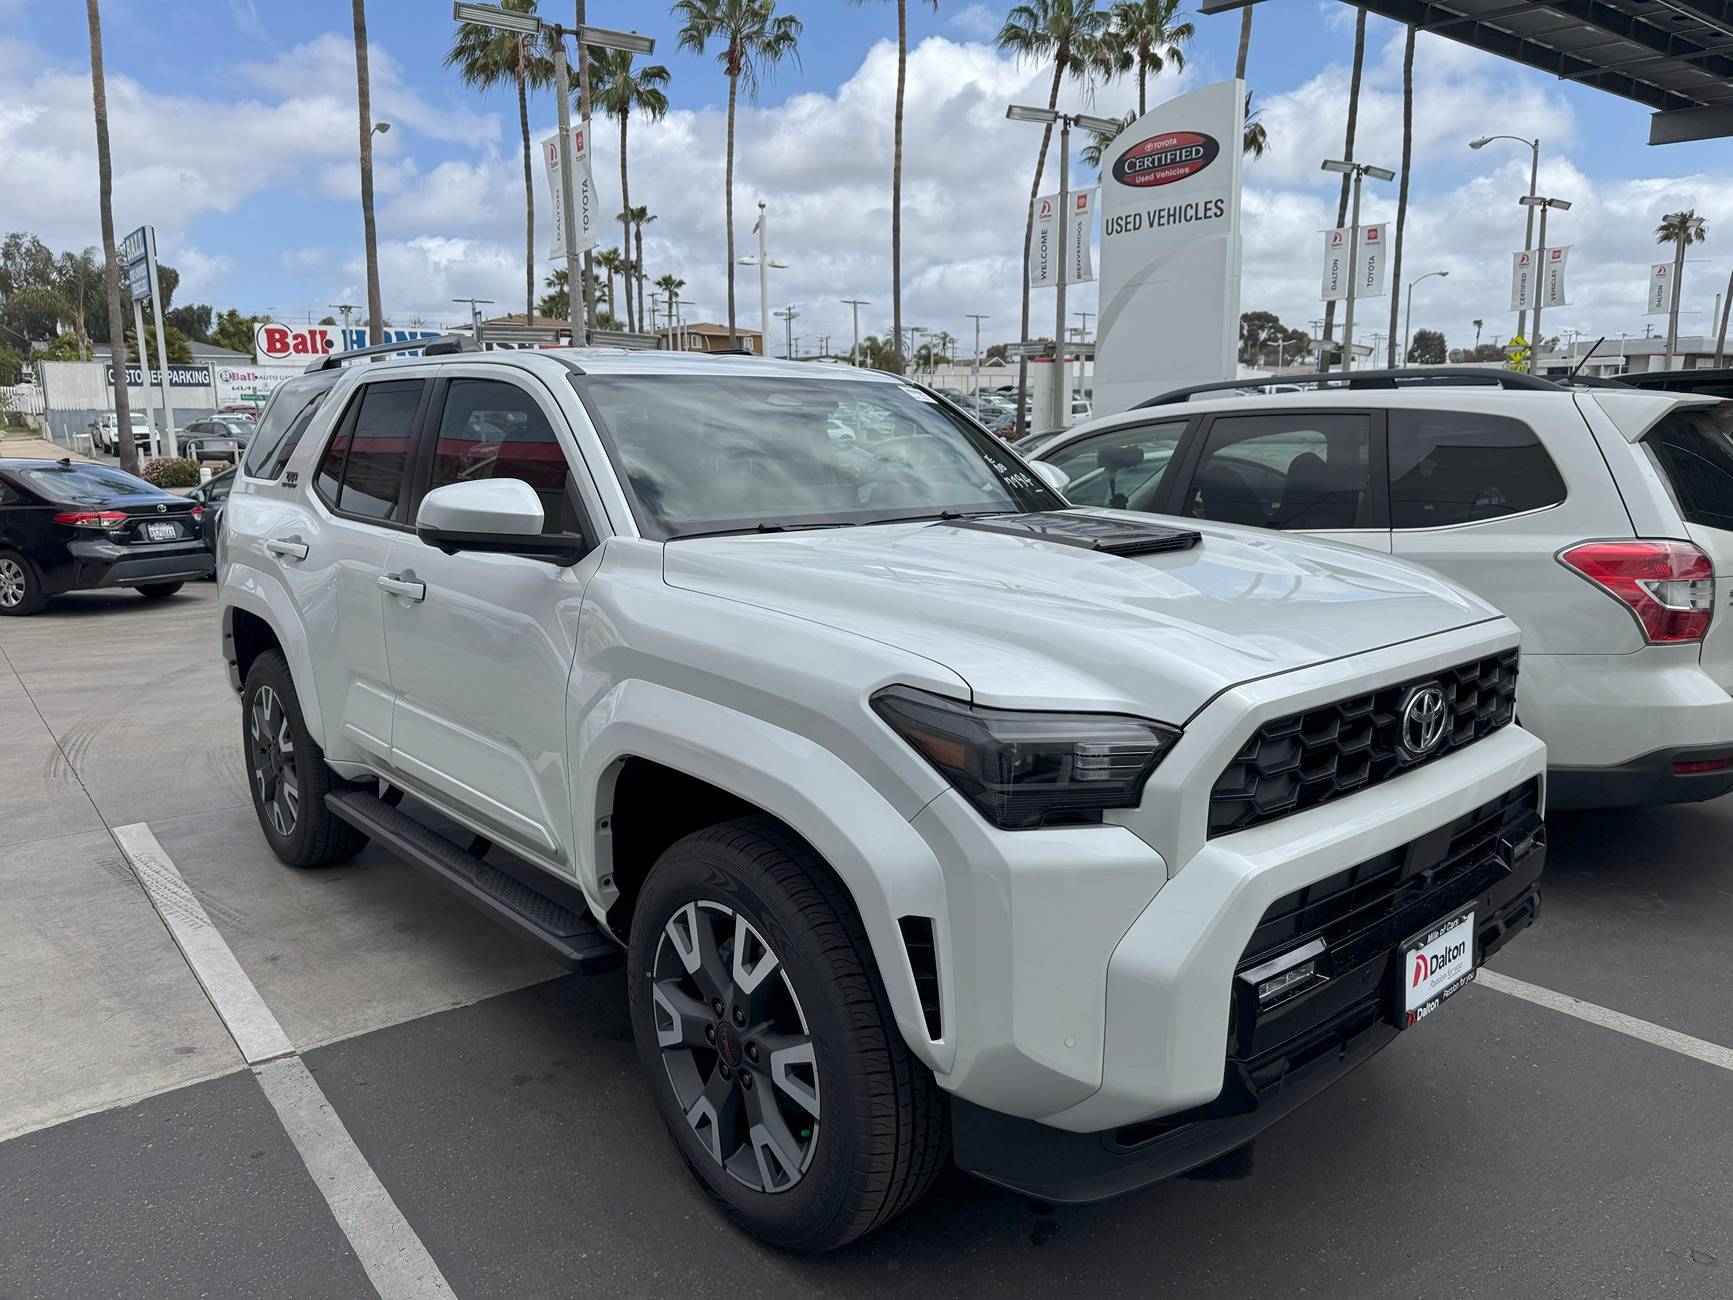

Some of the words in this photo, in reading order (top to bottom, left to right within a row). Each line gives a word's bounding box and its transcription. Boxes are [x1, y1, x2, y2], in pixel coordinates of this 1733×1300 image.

[1154, 138, 1177, 149] TOYOTA
[1124, 146, 1204, 173] CERTIFIED
[1135, 173, 1155, 184] Used
[1156, 166, 1190, 179] Vehicles
[582, 178, 590, 233] TOYOTA
[1105, 213, 1142, 236] USED
[1147, 198, 1225, 229] VEHICLES
[1040, 228, 1048, 280] WELCOME
[1331, 258, 1339, 291] DALTON
[1366, 255, 1375, 288] TOYOTA
[1656, 284, 1664, 308] DALTON
[265, 328, 329, 355] Ball
[108, 369, 162, 383] CSTOER
[168, 369, 209, 384] PARKING
[231, 372, 255, 381] Ball
[1427, 930, 1439, 944] Mile
[1440, 923, 1447, 936] of
[1447, 918, 1459, 931] Cars
[1429, 940, 1465, 976] Dalton
[1417, 998, 1440, 1022] Dalton
[1443, 982, 1459, 999] Passion
